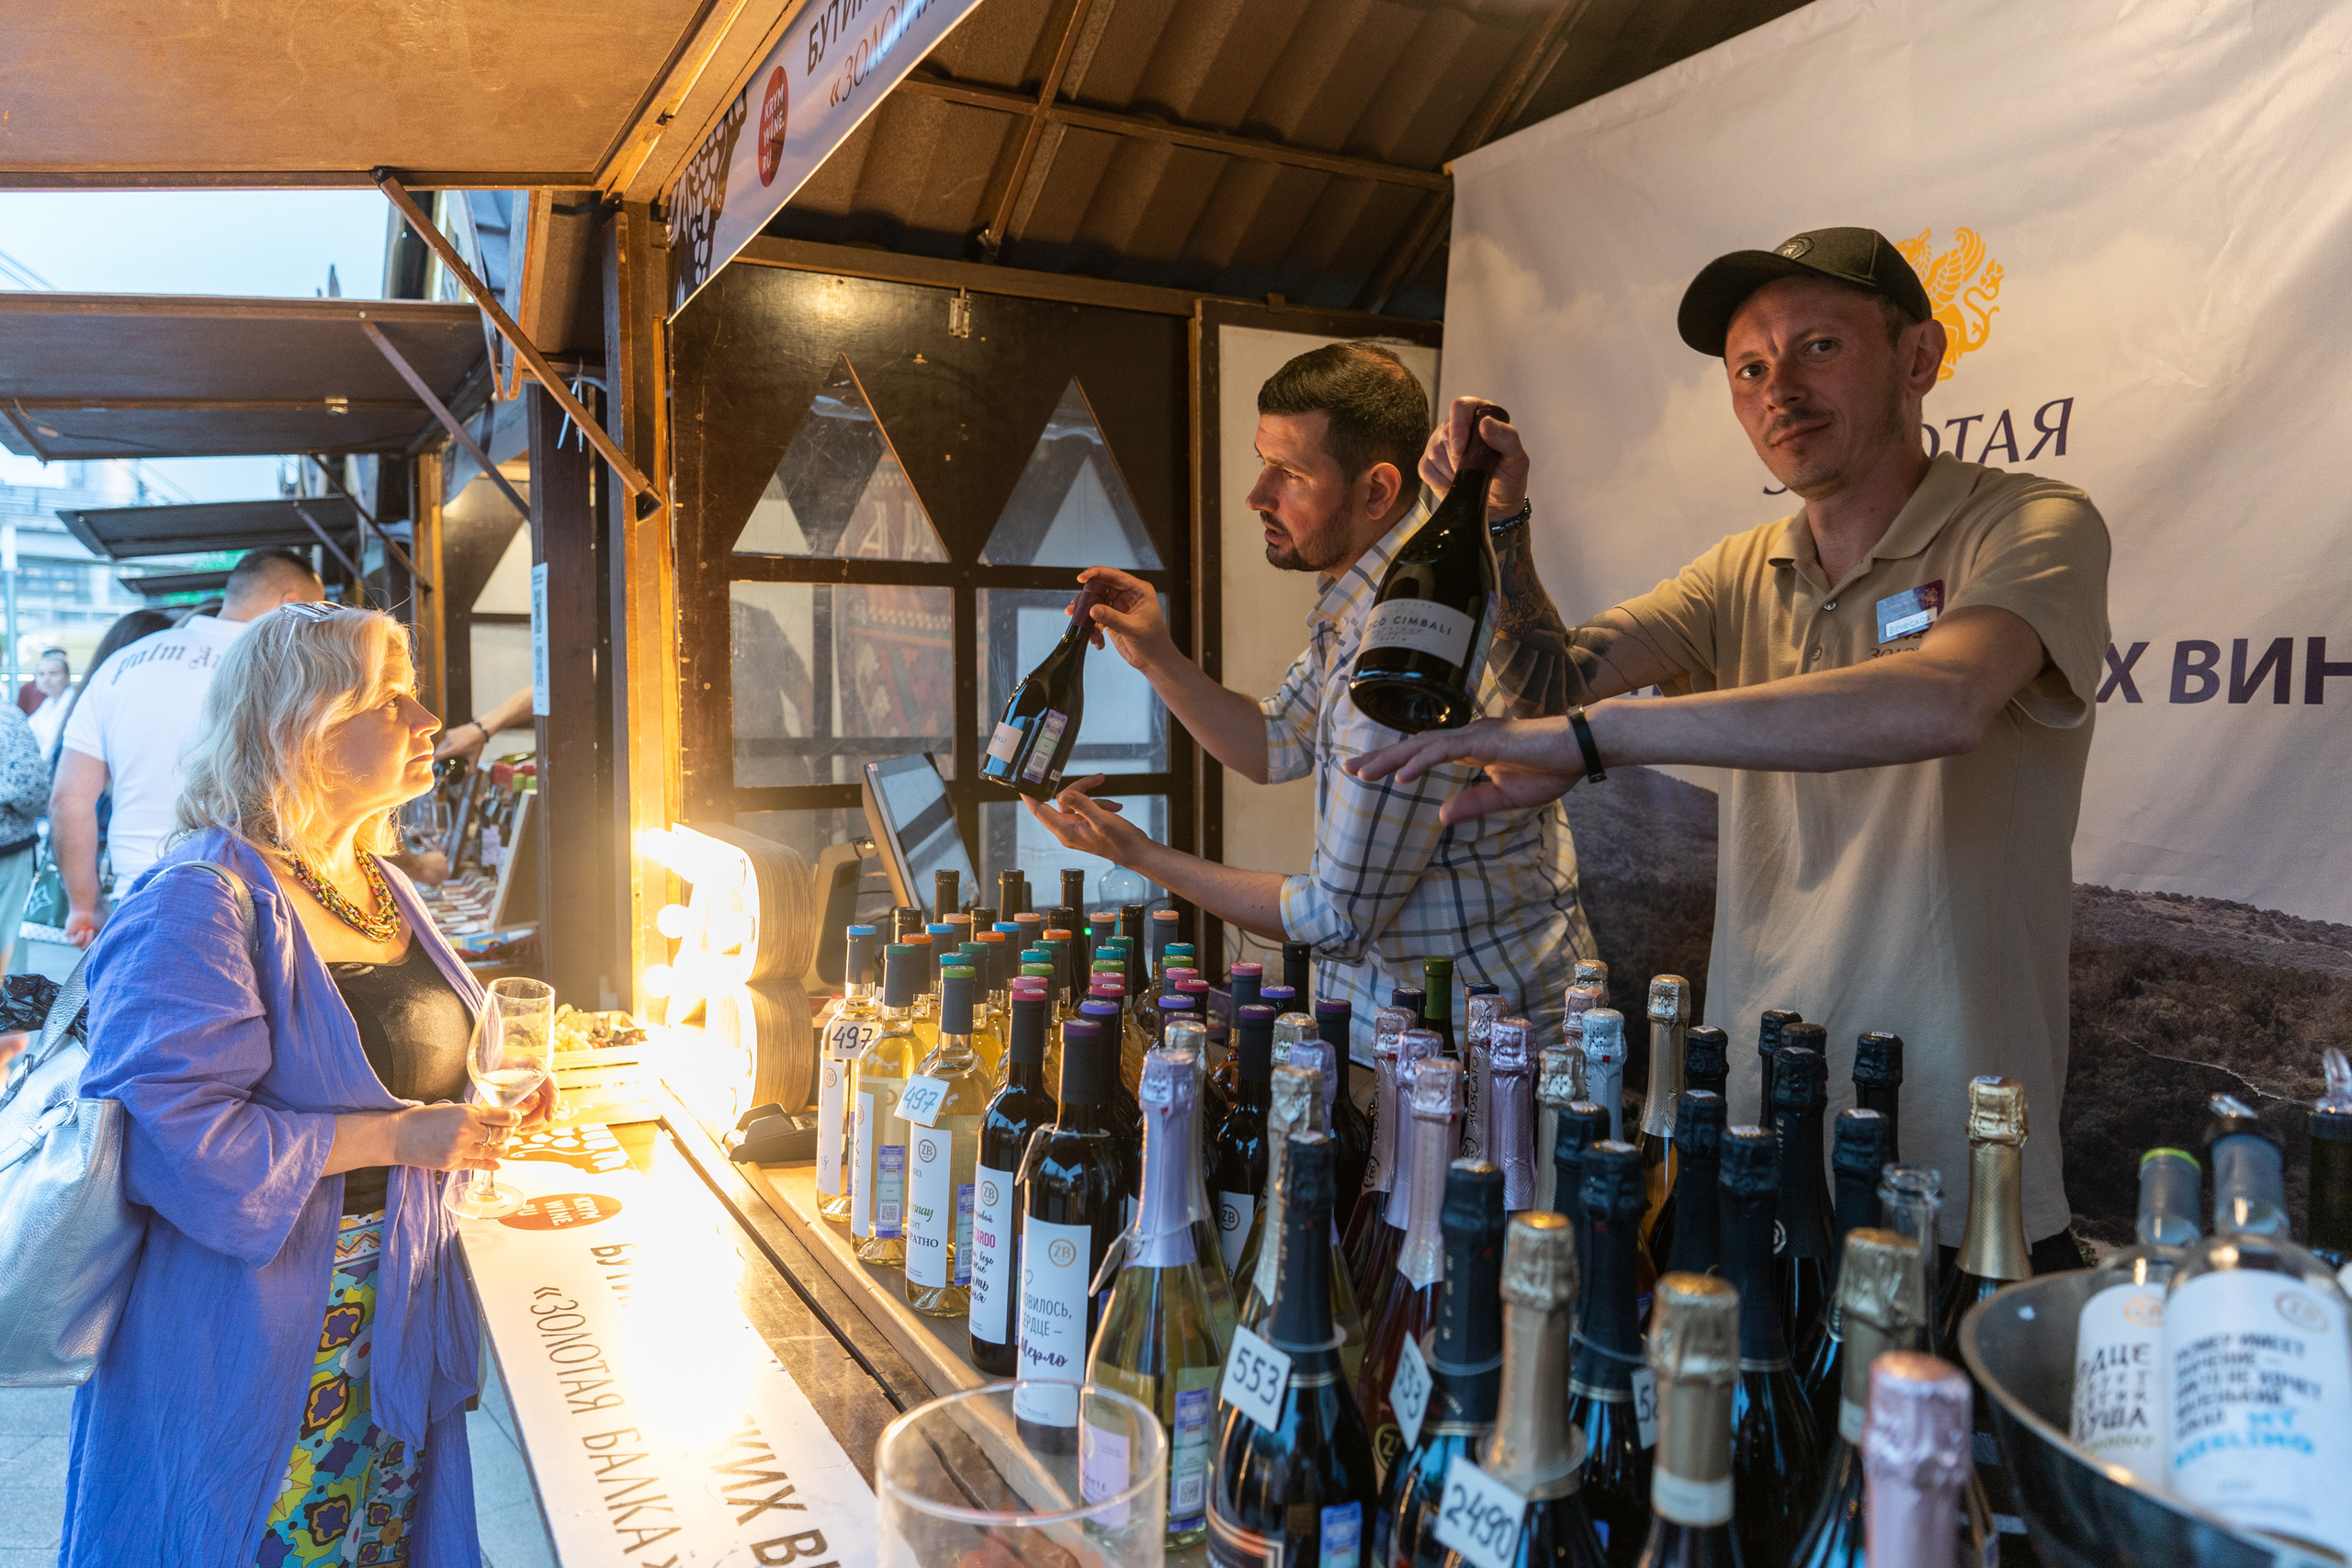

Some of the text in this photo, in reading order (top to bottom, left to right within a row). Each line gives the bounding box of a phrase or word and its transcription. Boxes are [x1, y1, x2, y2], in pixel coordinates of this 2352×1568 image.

[808, 0, 868, 77] БУТИ
[764, 84, 784, 122] KRYM
[762, 149, 772, 175] RU
[1394, 615, 1452, 636] CIMBALI
[832, 1026, 874, 1050] 497
[903, 1085, 939, 1114] 497
[922, 1145, 933, 1156] ZB
[983, 1186, 995, 1200] ZB
[1055, 1247, 1070, 1258] ZB
[530, 1286, 626, 1415] «ЗОЛОТАЯ
[1232, 1347, 1282, 1406] 553
[1445, 1483, 1515, 1562] 2490
